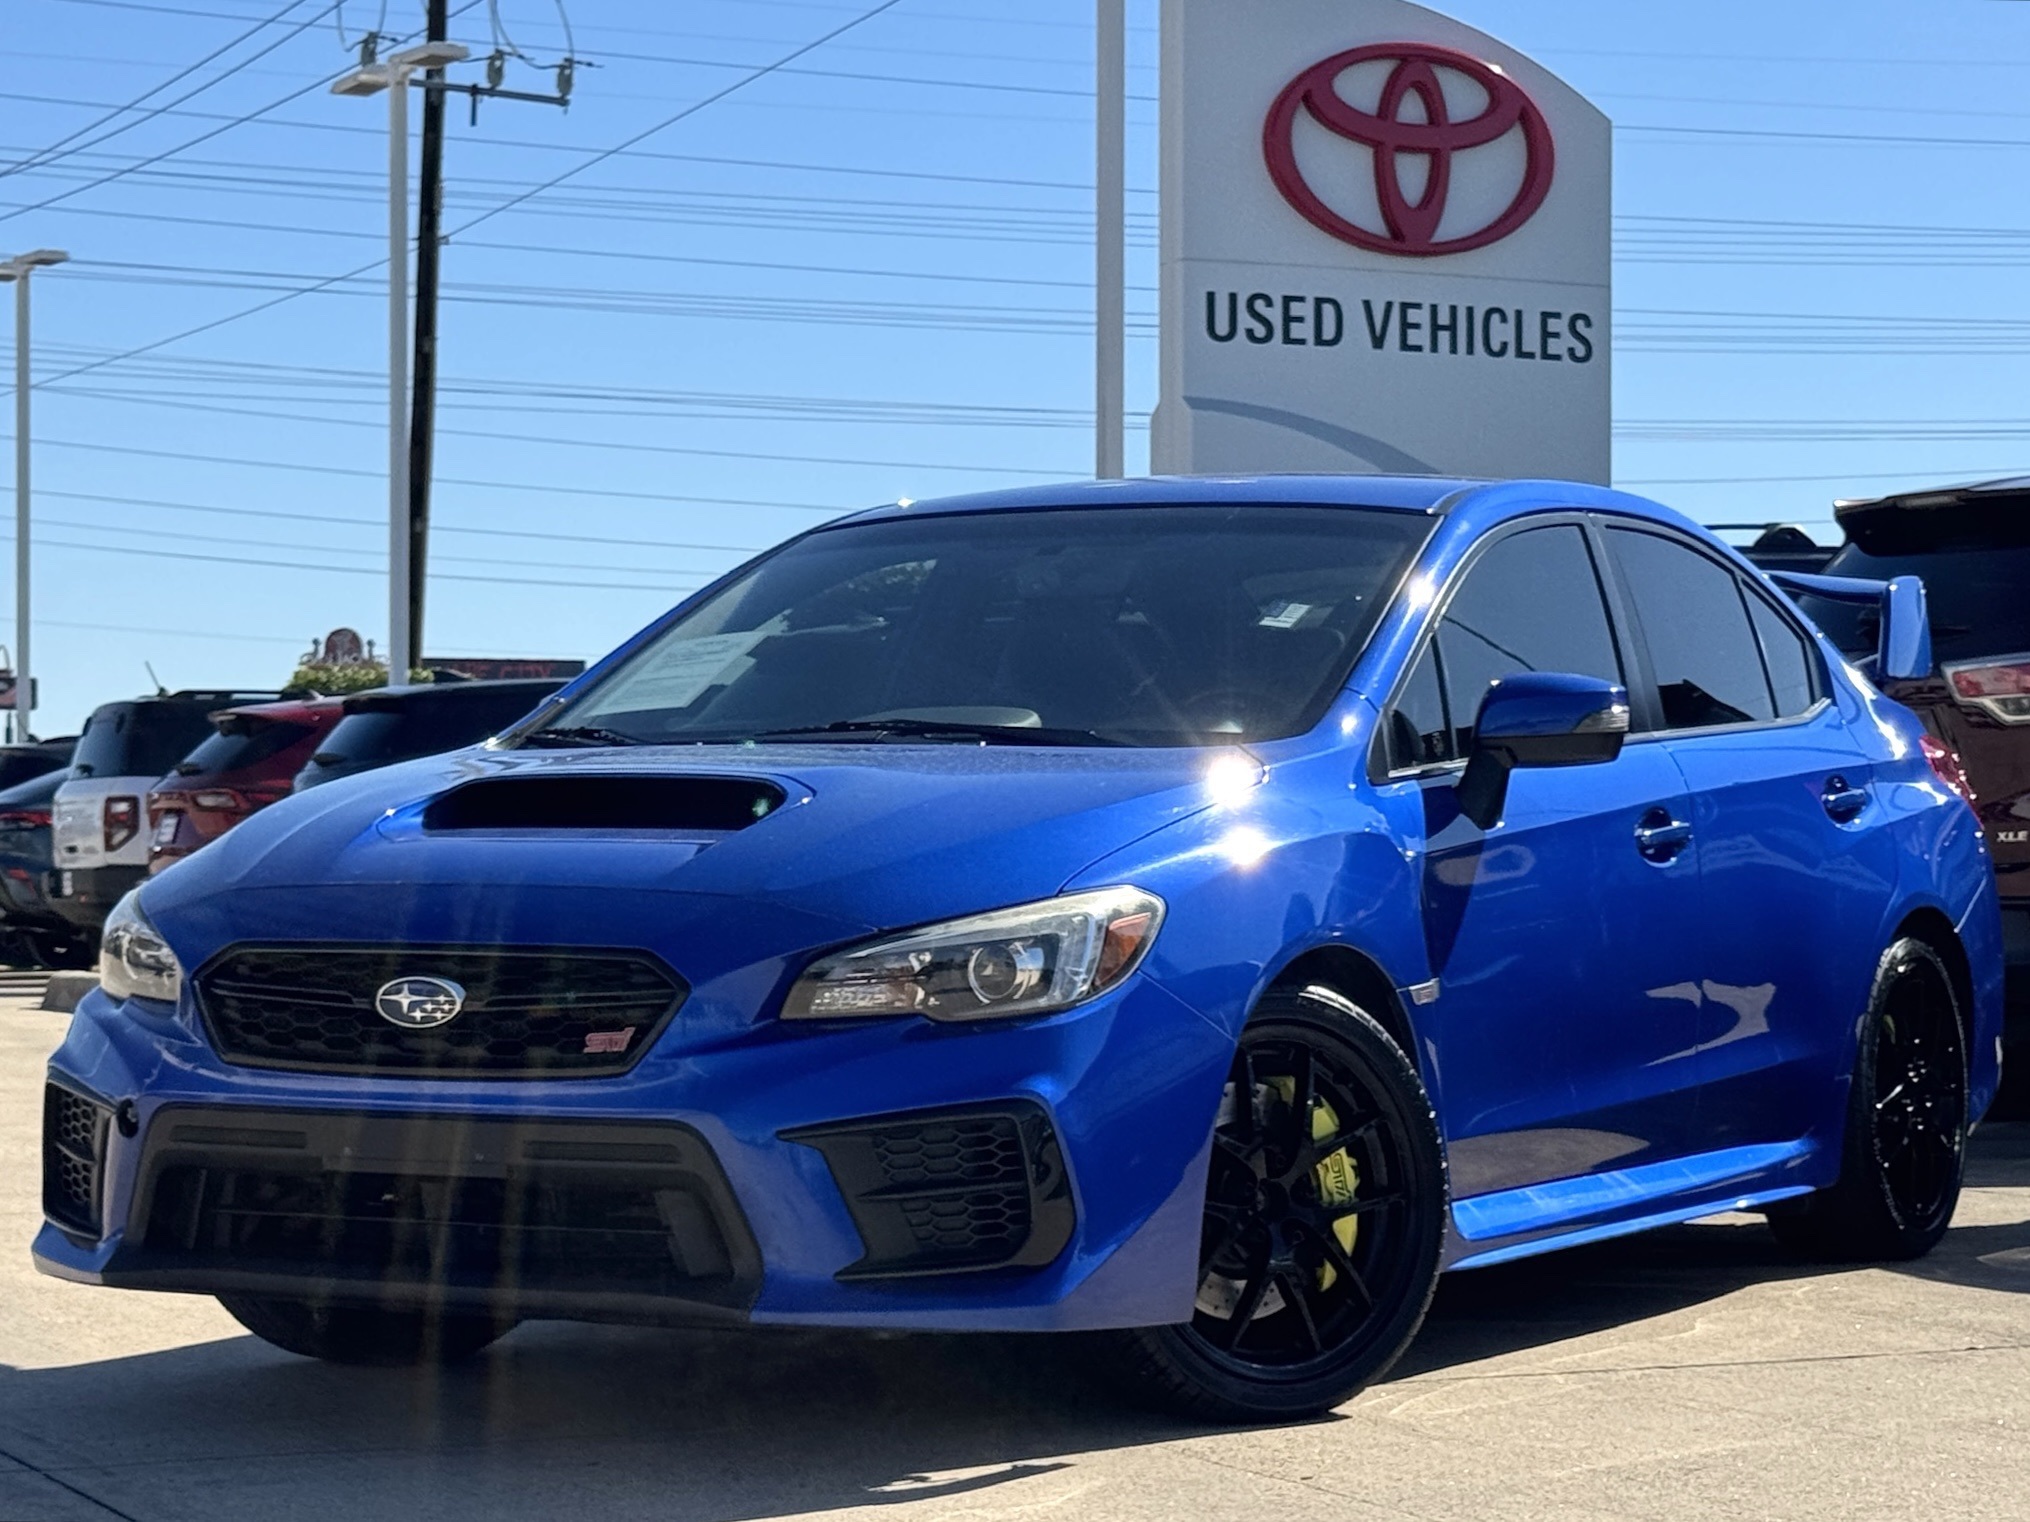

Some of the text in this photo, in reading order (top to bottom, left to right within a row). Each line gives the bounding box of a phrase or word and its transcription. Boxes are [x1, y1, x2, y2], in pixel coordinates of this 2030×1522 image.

[1206, 291, 1593, 364] USED VEHICLES
[1996, 830, 2029, 843] XLE
